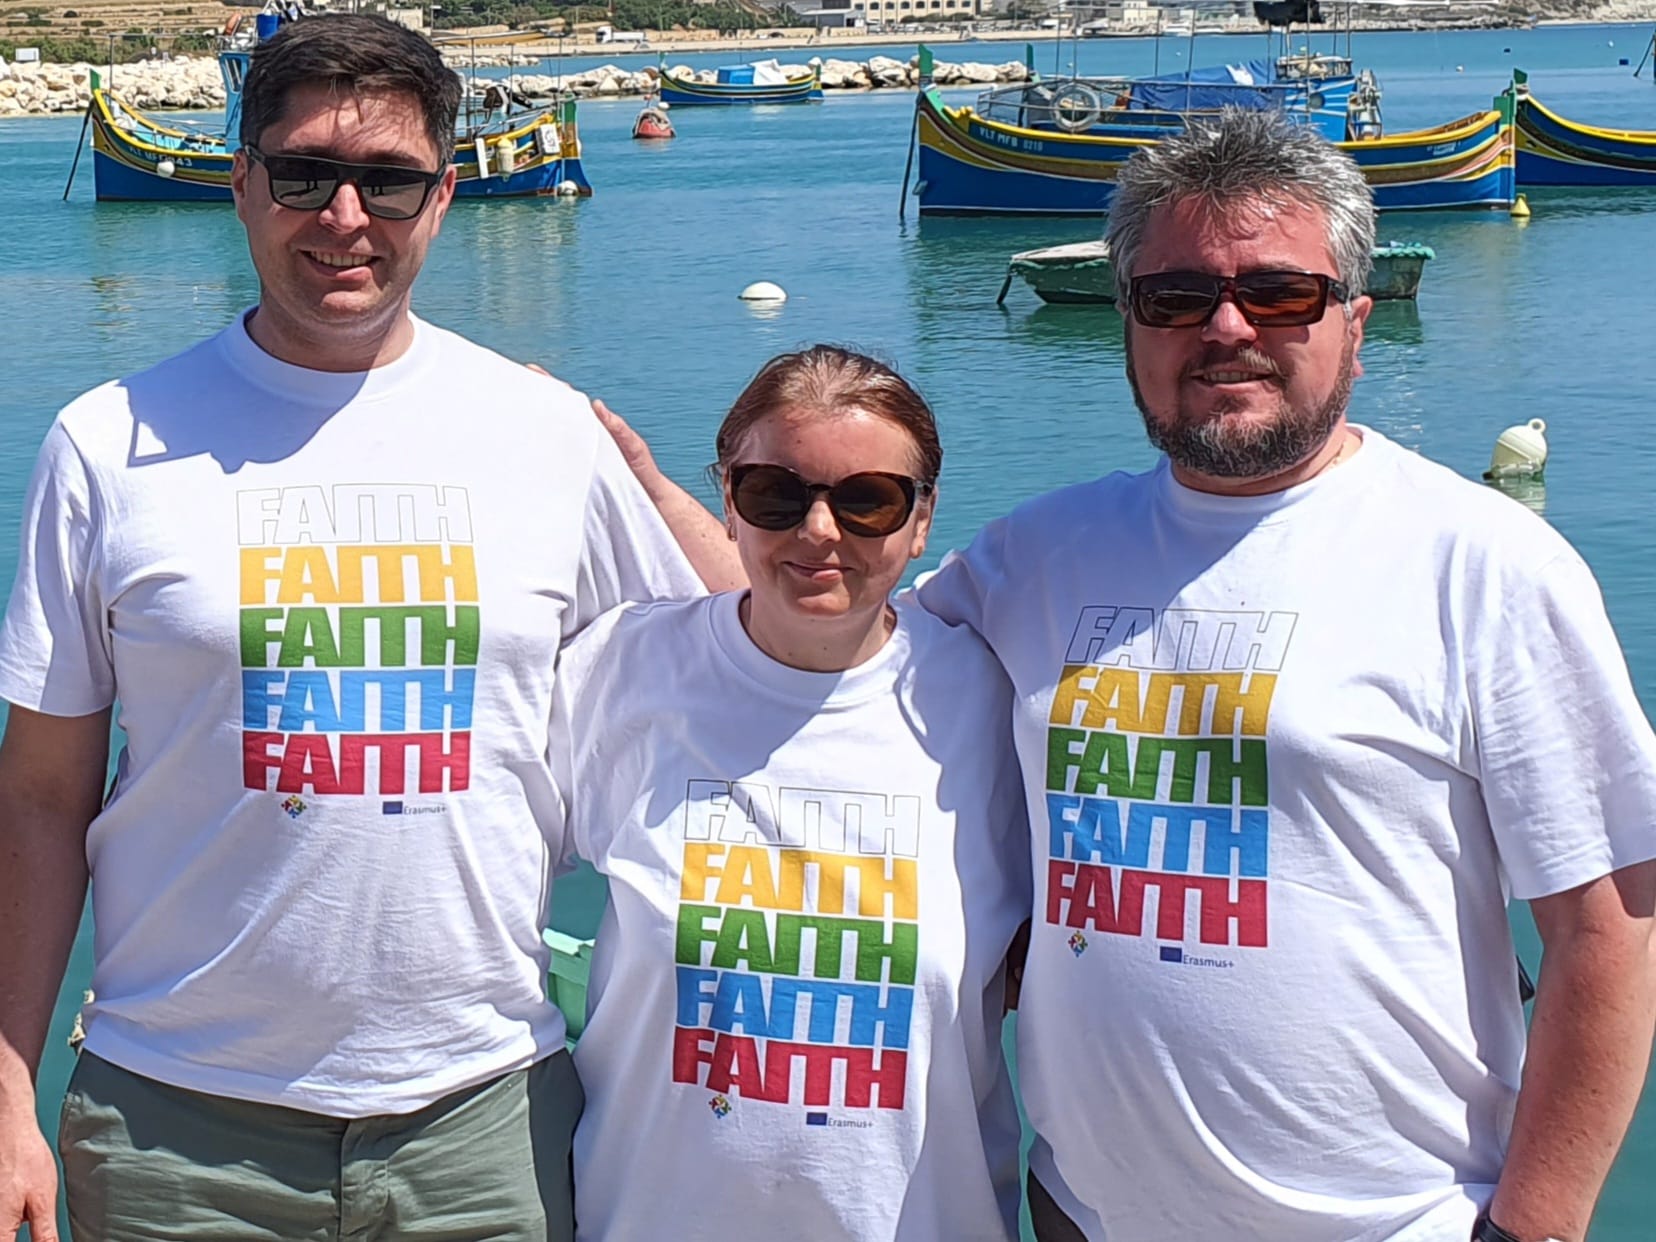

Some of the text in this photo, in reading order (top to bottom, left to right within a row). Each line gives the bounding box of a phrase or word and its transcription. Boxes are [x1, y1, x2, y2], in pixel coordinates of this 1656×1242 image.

[236, 483, 474, 545] FAITH
[239, 544, 479, 604] FAITH
[239, 605, 481, 667] FAITH
[1063, 605, 1299, 672] FAITH
[241, 668, 477, 732] FAITH
[1047, 664, 1278, 736] FAITH
[242, 731, 471, 795] FAITH
[1045, 727, 1269, 807] FAITH
[684, 779, 921, 858] FAITH
[1045, 793, 1269, 877] FAITH
[679, 842, 918, 920] FAITH
[1046, 859, 1268, 948] FAITH
[675, 903, 919, 986] FAITH
[1183, 954, 1234, 968] Erasmus+
[675, 965, 914, 1049] FAITH
[672, 1025, 908, 1110] FAITH
[828, 1117, 873, 1128] Erasmus+
